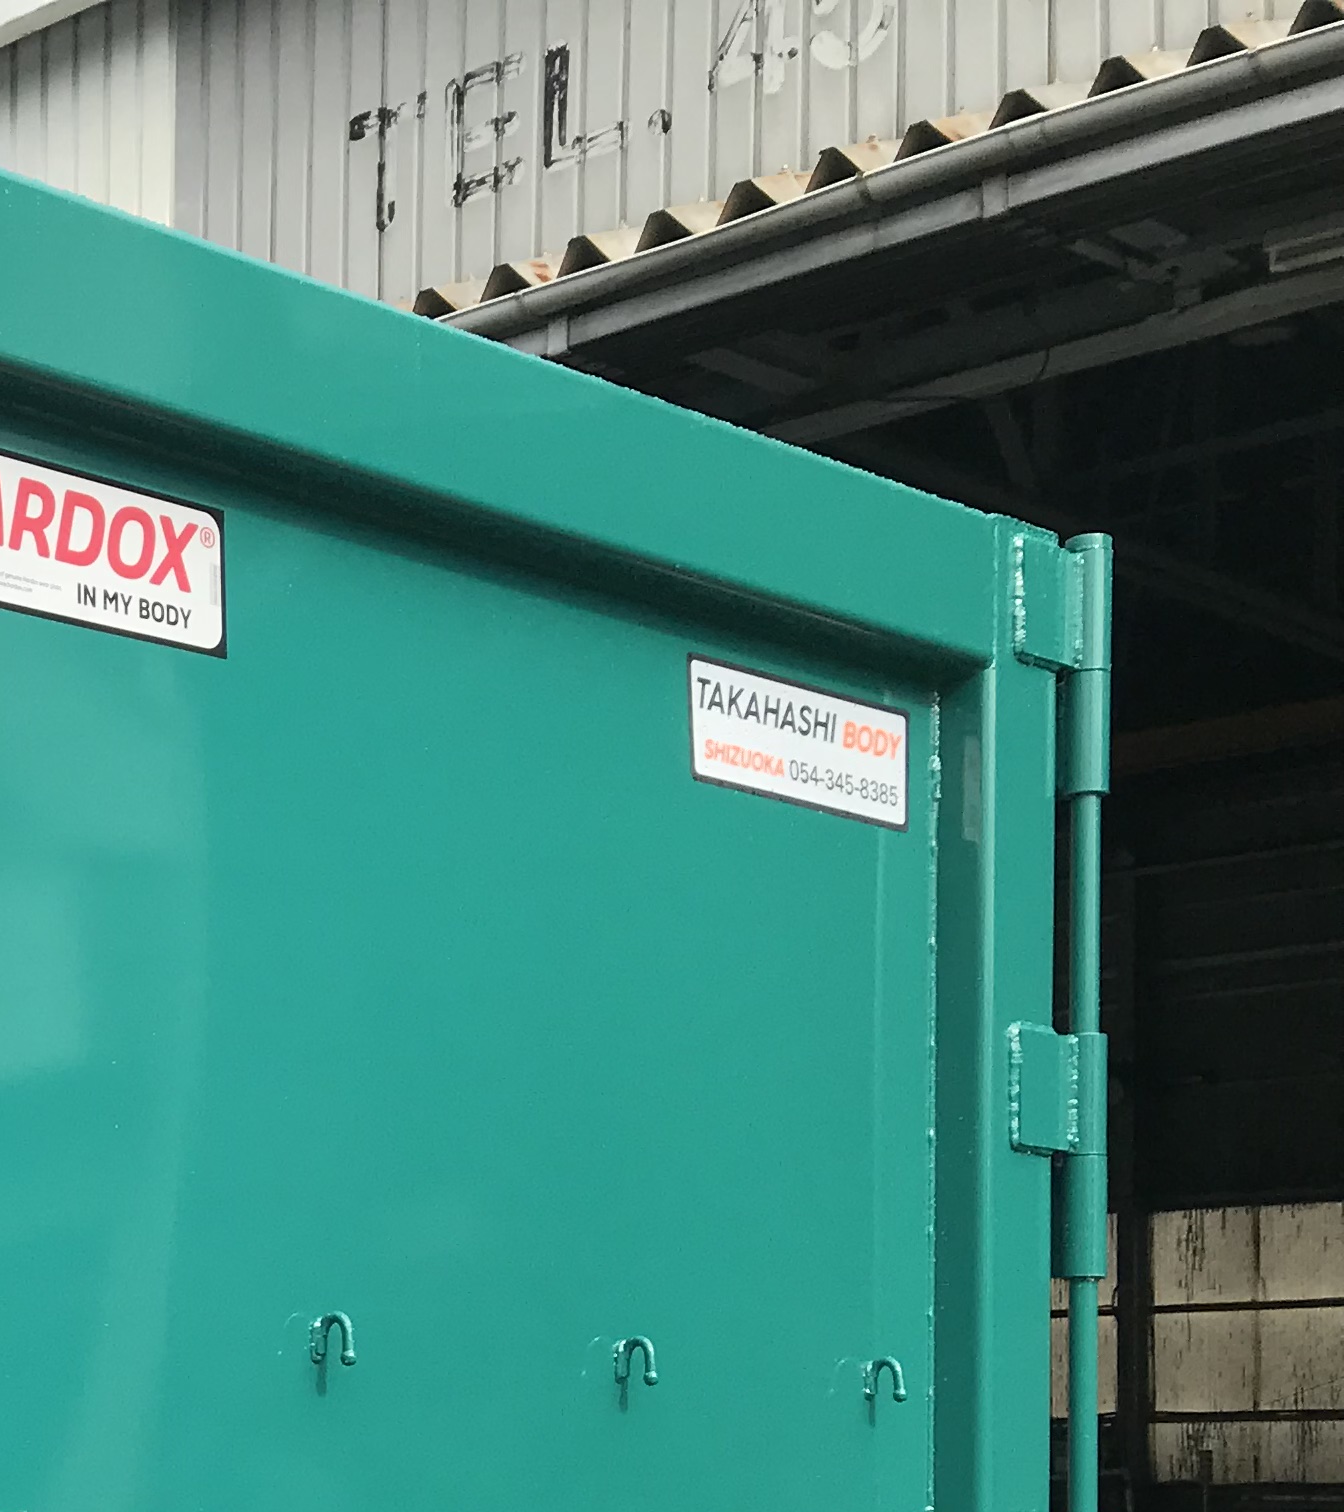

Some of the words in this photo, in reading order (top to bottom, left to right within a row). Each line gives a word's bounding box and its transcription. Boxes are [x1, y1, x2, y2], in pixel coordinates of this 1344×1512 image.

[77, 582, 97, 608] IN
[103, 588, 133, 616] MY
[139, 597, 193, 630] BODY
[696, 676, 838, 744] TAKAHASHI
[841, 719, 903, 761] BODY
[703, 738, 786, 778] SHIZUOKA
[788, 758, 900, 808] 054-345-8385
